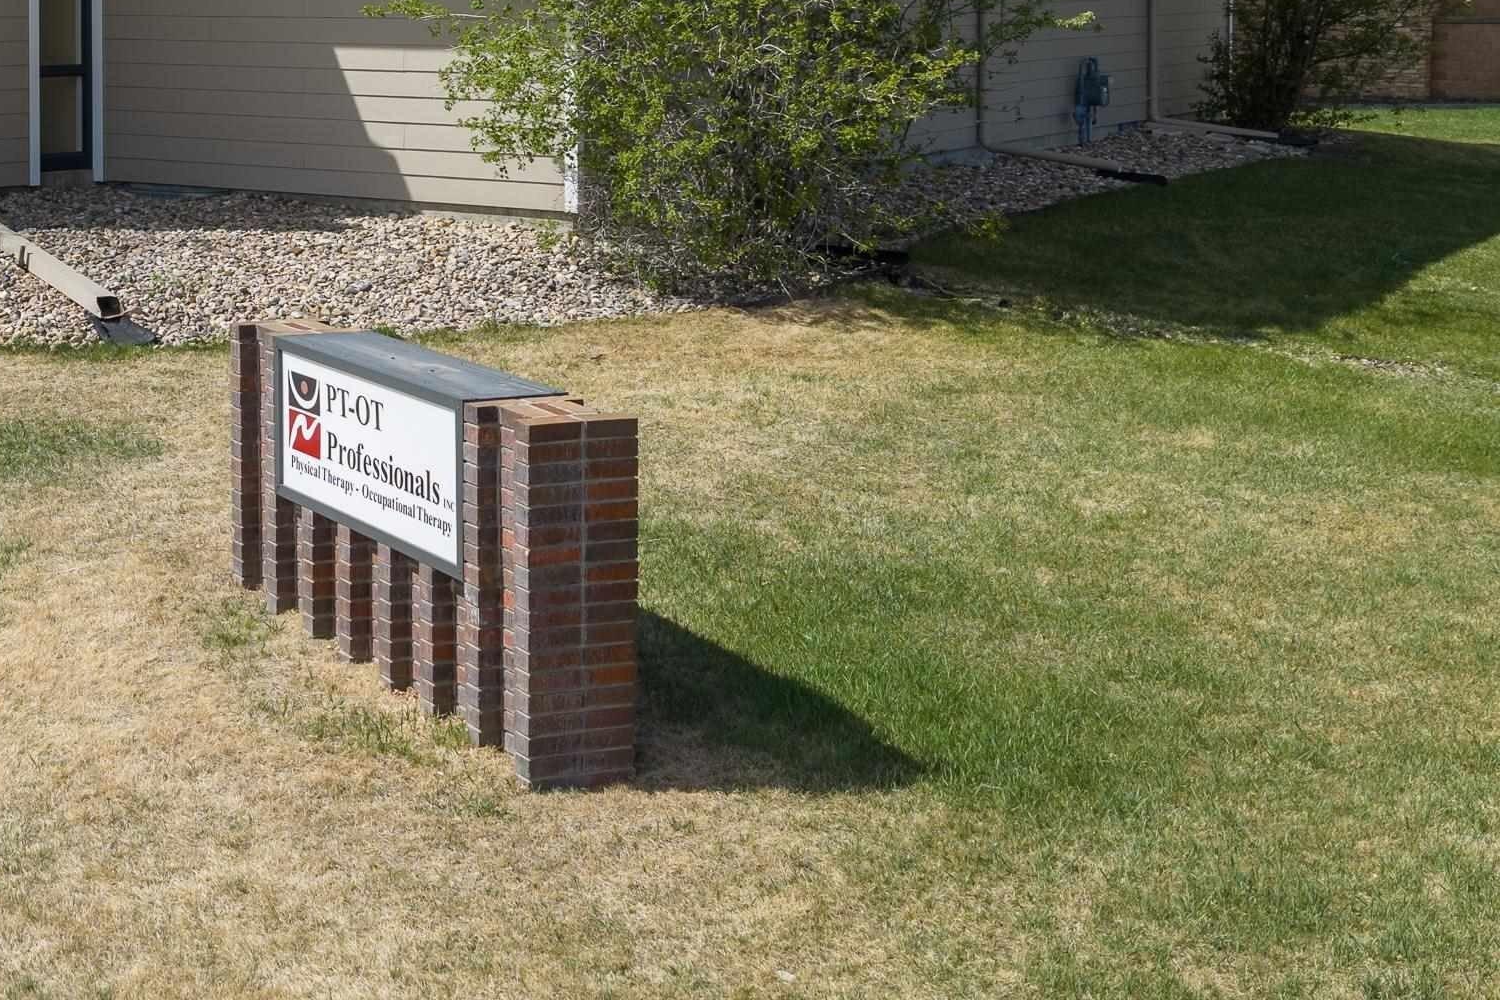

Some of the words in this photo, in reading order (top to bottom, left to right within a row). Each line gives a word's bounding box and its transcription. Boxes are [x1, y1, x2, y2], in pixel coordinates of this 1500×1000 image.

[326, 383, 384, 431] PT-OT
[291, 454, 321, 479] Physical
[322, 465, 354, 496] Therapy
[362, 486, 416, 519] Occupational
[416, 505, 452, 537] Therapy
[327, 431, 440, 505] Professionals
